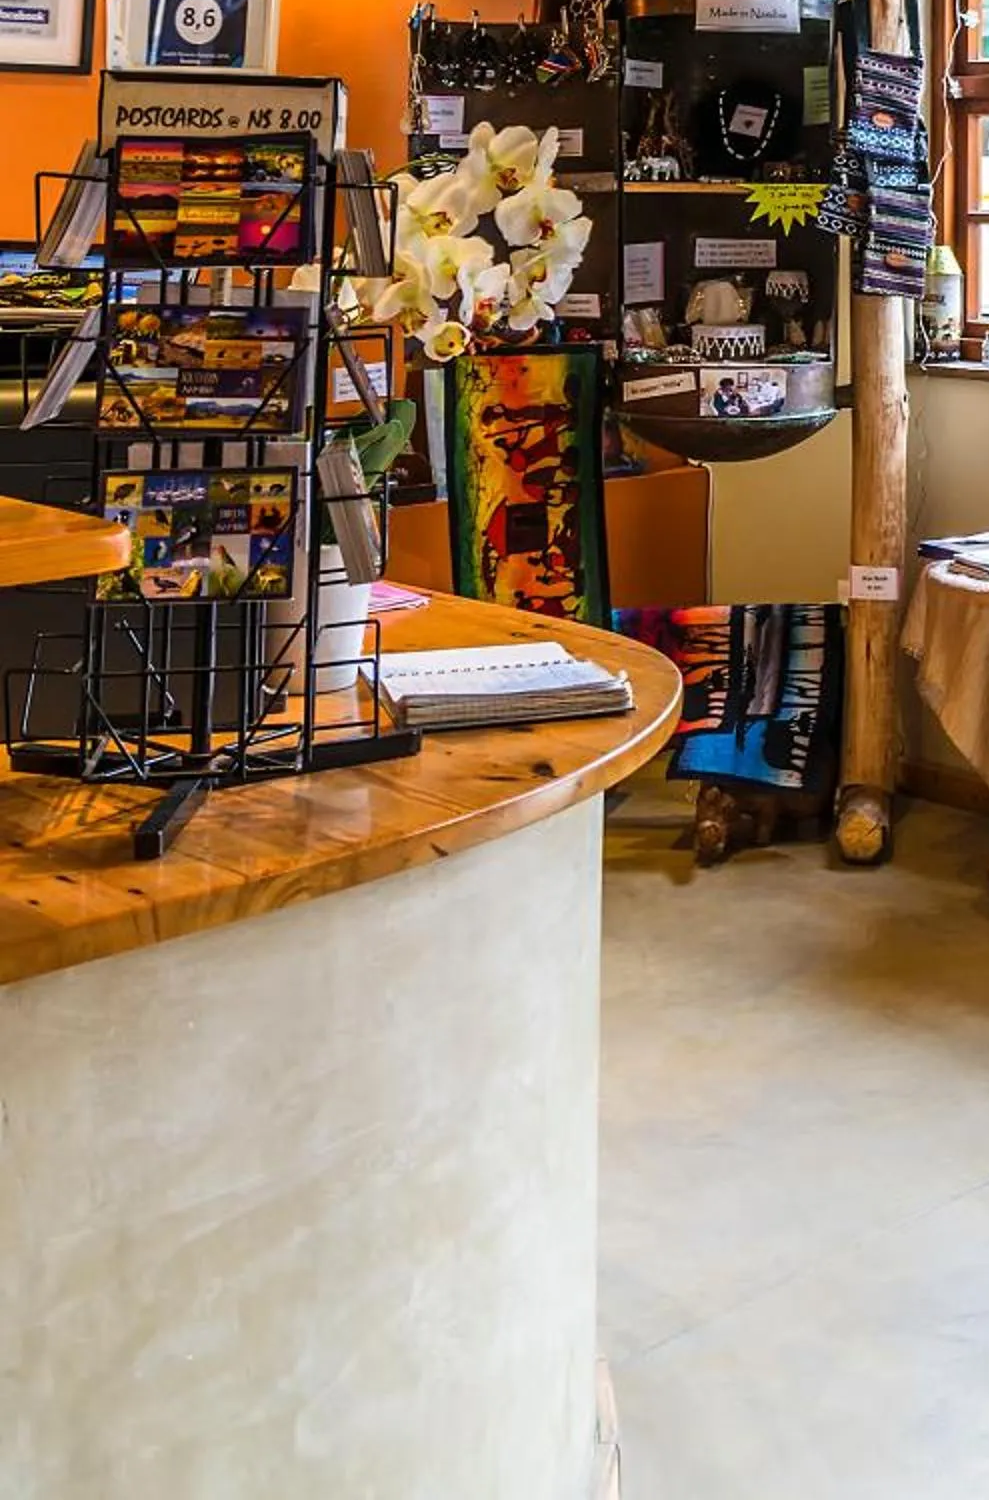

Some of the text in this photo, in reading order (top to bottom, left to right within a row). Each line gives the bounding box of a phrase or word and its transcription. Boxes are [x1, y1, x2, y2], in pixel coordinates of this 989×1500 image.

[183, 7, 215, 30] 8,6
[116, 105, 224, 128] POSTCARDS
[280, 108, 321, 129] 8.00
